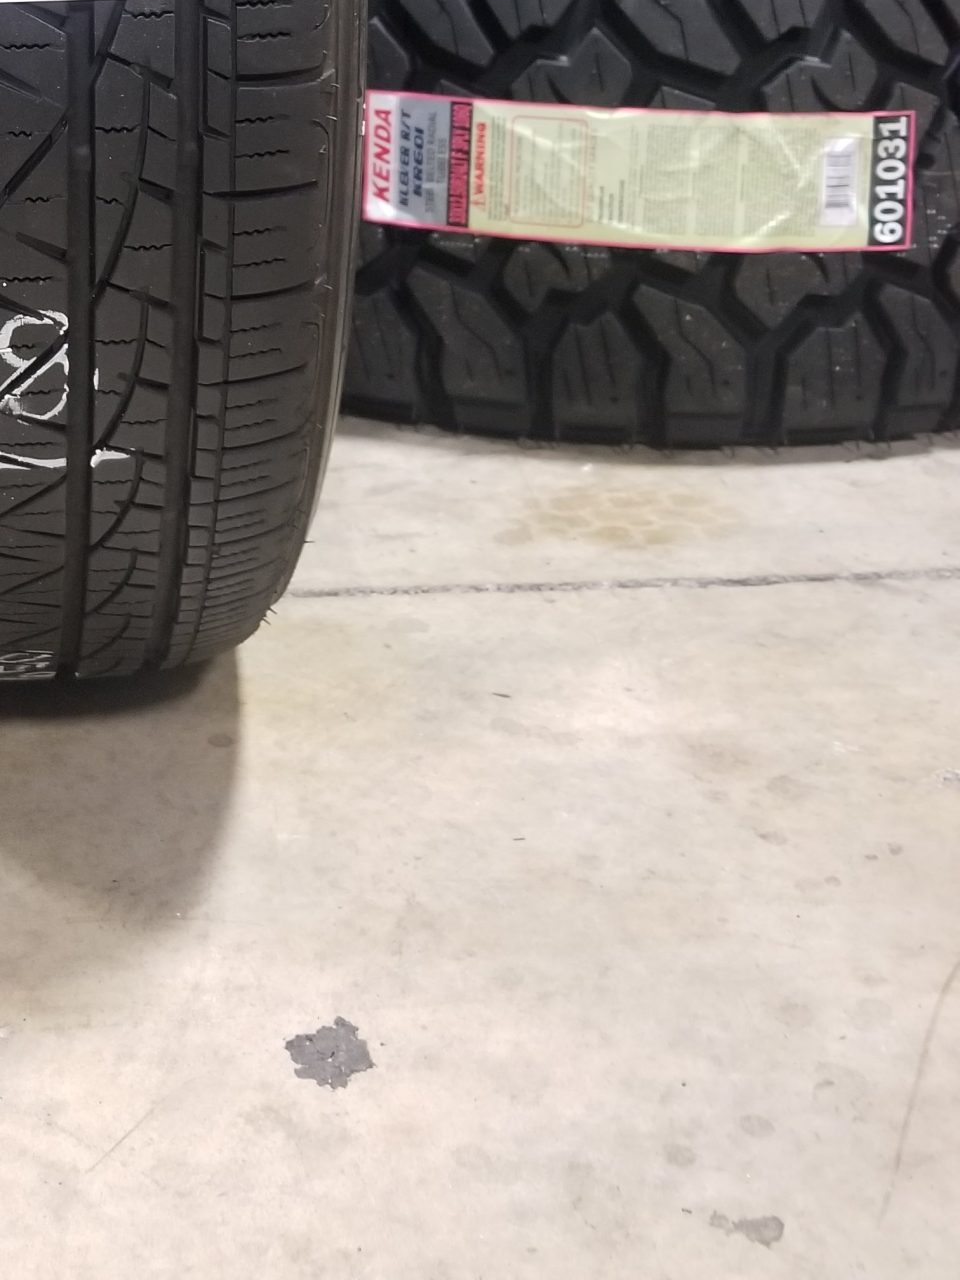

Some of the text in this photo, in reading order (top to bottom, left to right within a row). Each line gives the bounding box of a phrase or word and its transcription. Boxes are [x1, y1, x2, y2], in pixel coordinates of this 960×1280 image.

[373, 109, 391, 203] KENDA
[399, 108, 412, 207] KLEVER R/T
[473, 122, 487, 195] WARNING
[873, 115, 908, 244] 601031
